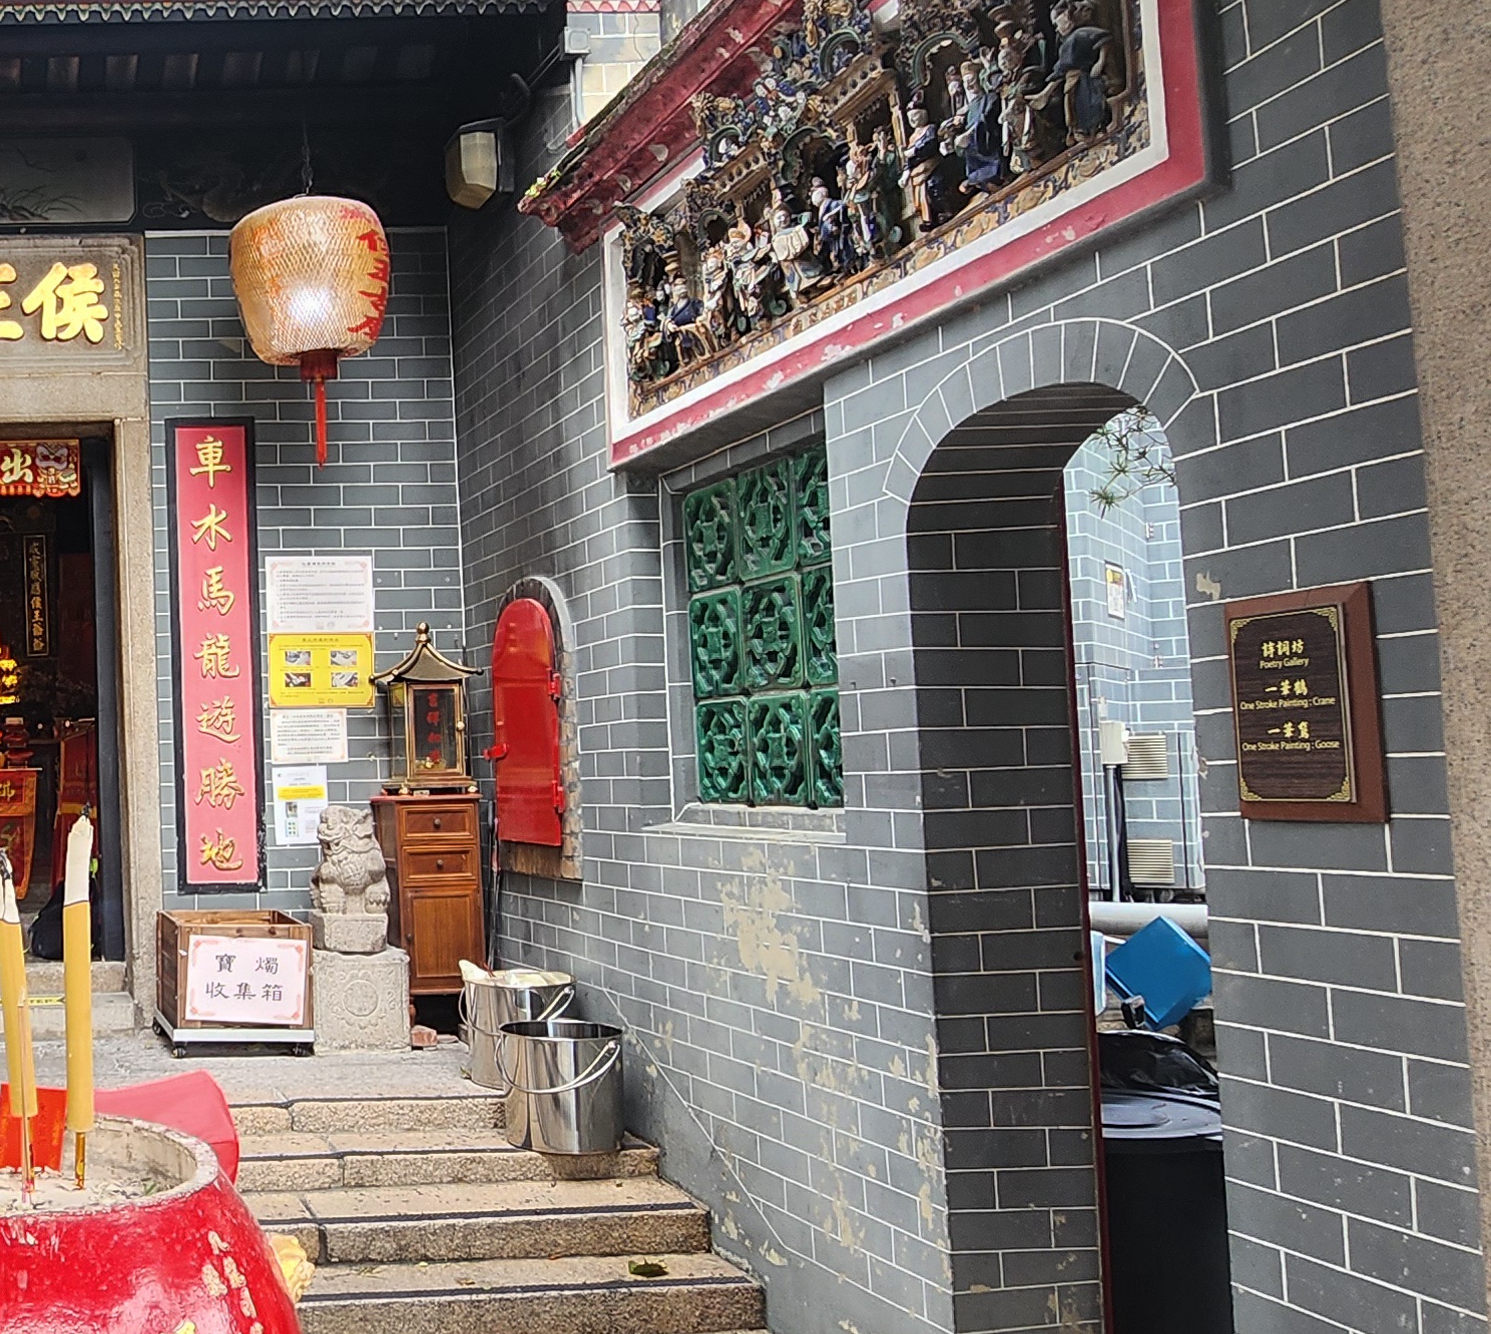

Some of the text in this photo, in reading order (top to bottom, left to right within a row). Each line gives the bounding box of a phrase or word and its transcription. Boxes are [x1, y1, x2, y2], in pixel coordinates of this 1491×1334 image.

[189, 435, 245, 874] 車水馬龍遊勝地
[1262, 638, 1305, 658] 詩詞坊
[1259, 656, 1309, 669] Poetry Gallery
[1240, 702, 1255, 710] One
[1255, 699, 1278, 709] Stroke
[1278, 698, 1308, 708] Painting
[1313, 697, 1336, 705] Crane
[1242, 742, 1257, 751] One
[1257, 741, 1280, 751] Stroke
[1280, 740, 1311, 751] Painting
[1315, 739, 1340, 749] Goose
[205, 981, 284, 1002] 收集箱
